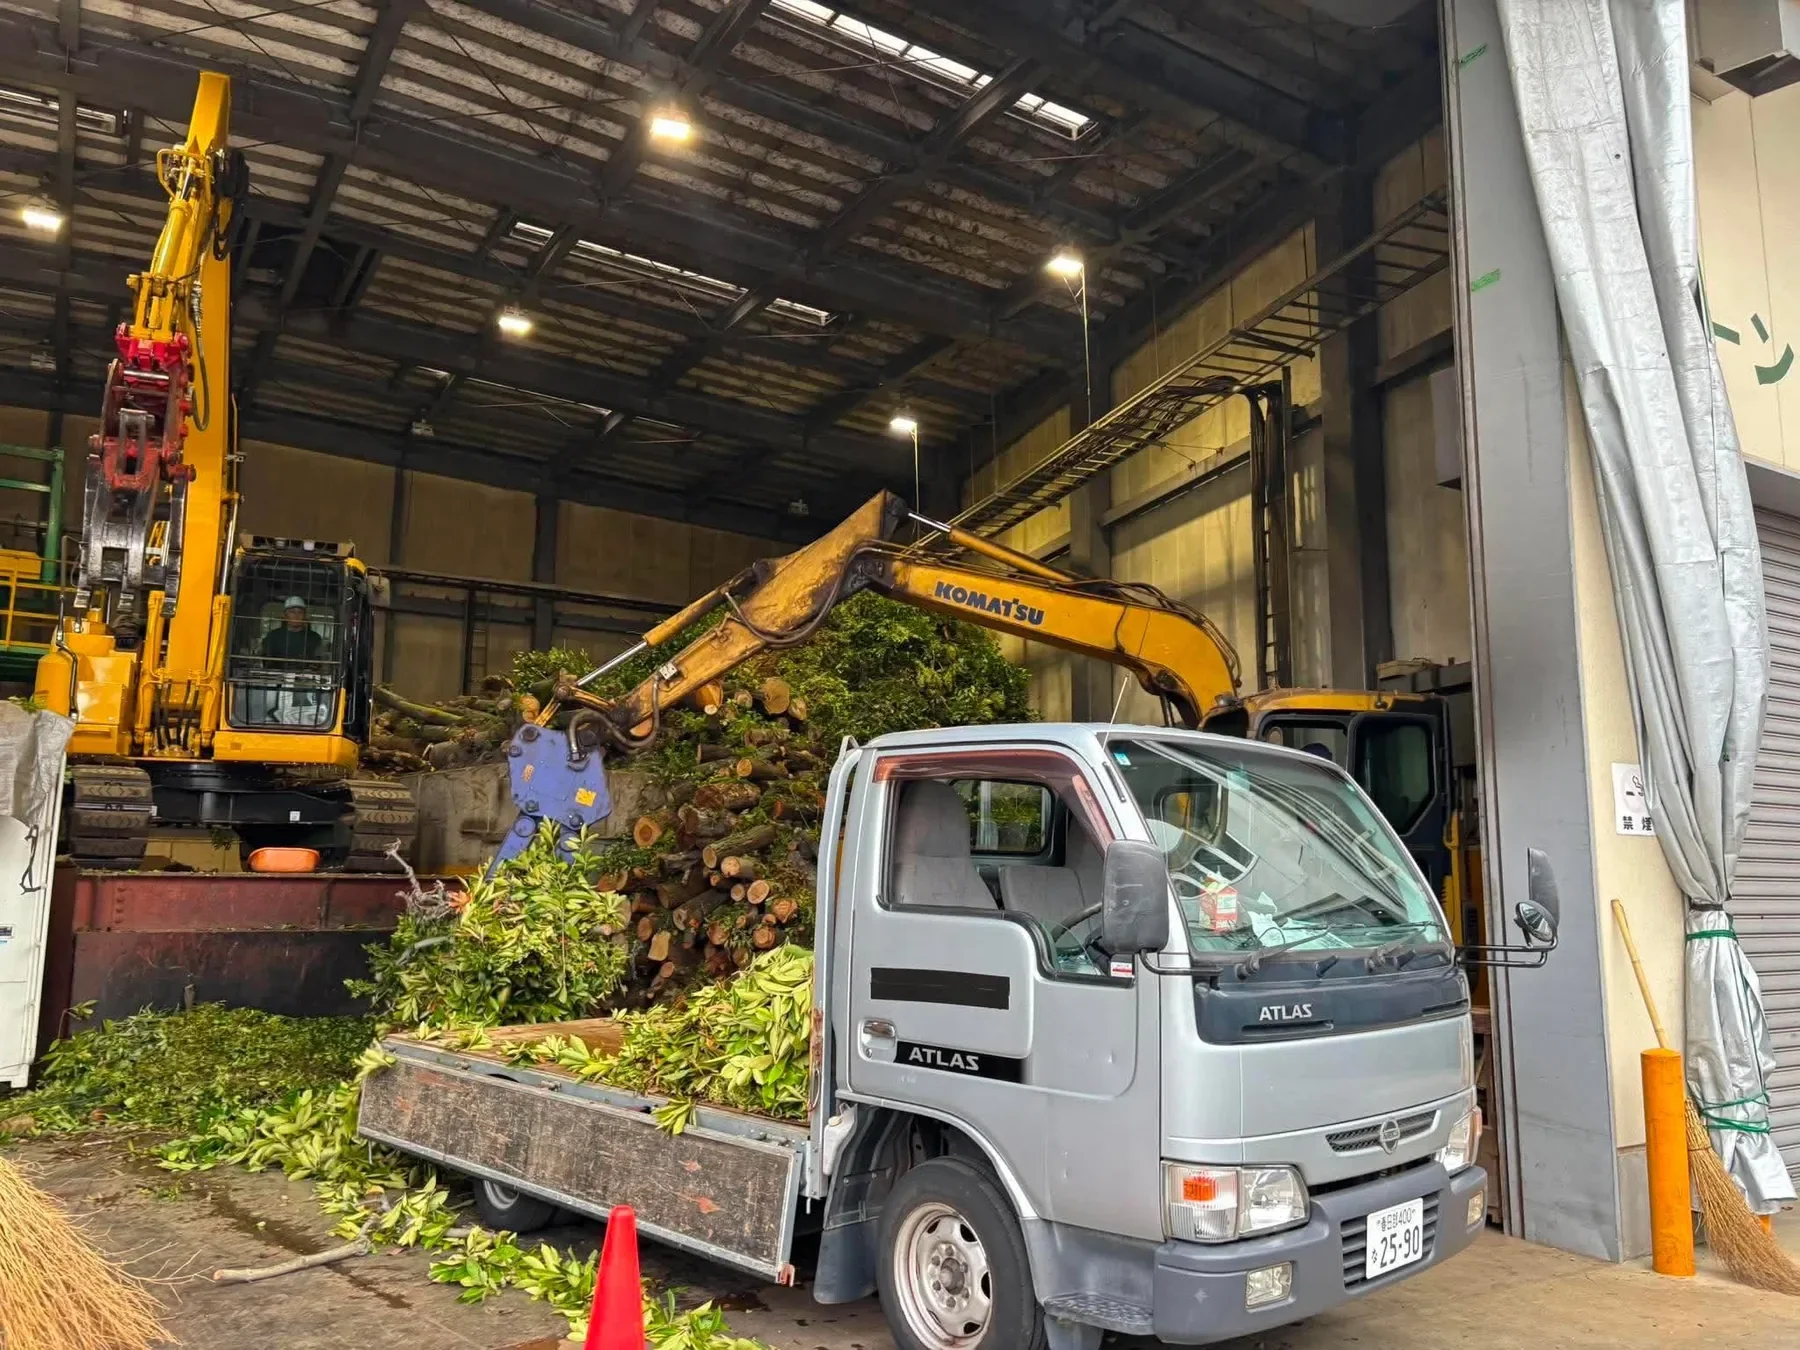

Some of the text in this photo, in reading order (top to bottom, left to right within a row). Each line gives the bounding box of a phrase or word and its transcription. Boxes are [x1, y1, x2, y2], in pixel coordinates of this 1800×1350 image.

[935, 581, 1044, 625] KOMATSU
[1623, 816, 1652, 831] 禁煙
[1259, 1004, 1312, 1021] ATLAS
[909, 1047, 979, 1071] ATLAS
